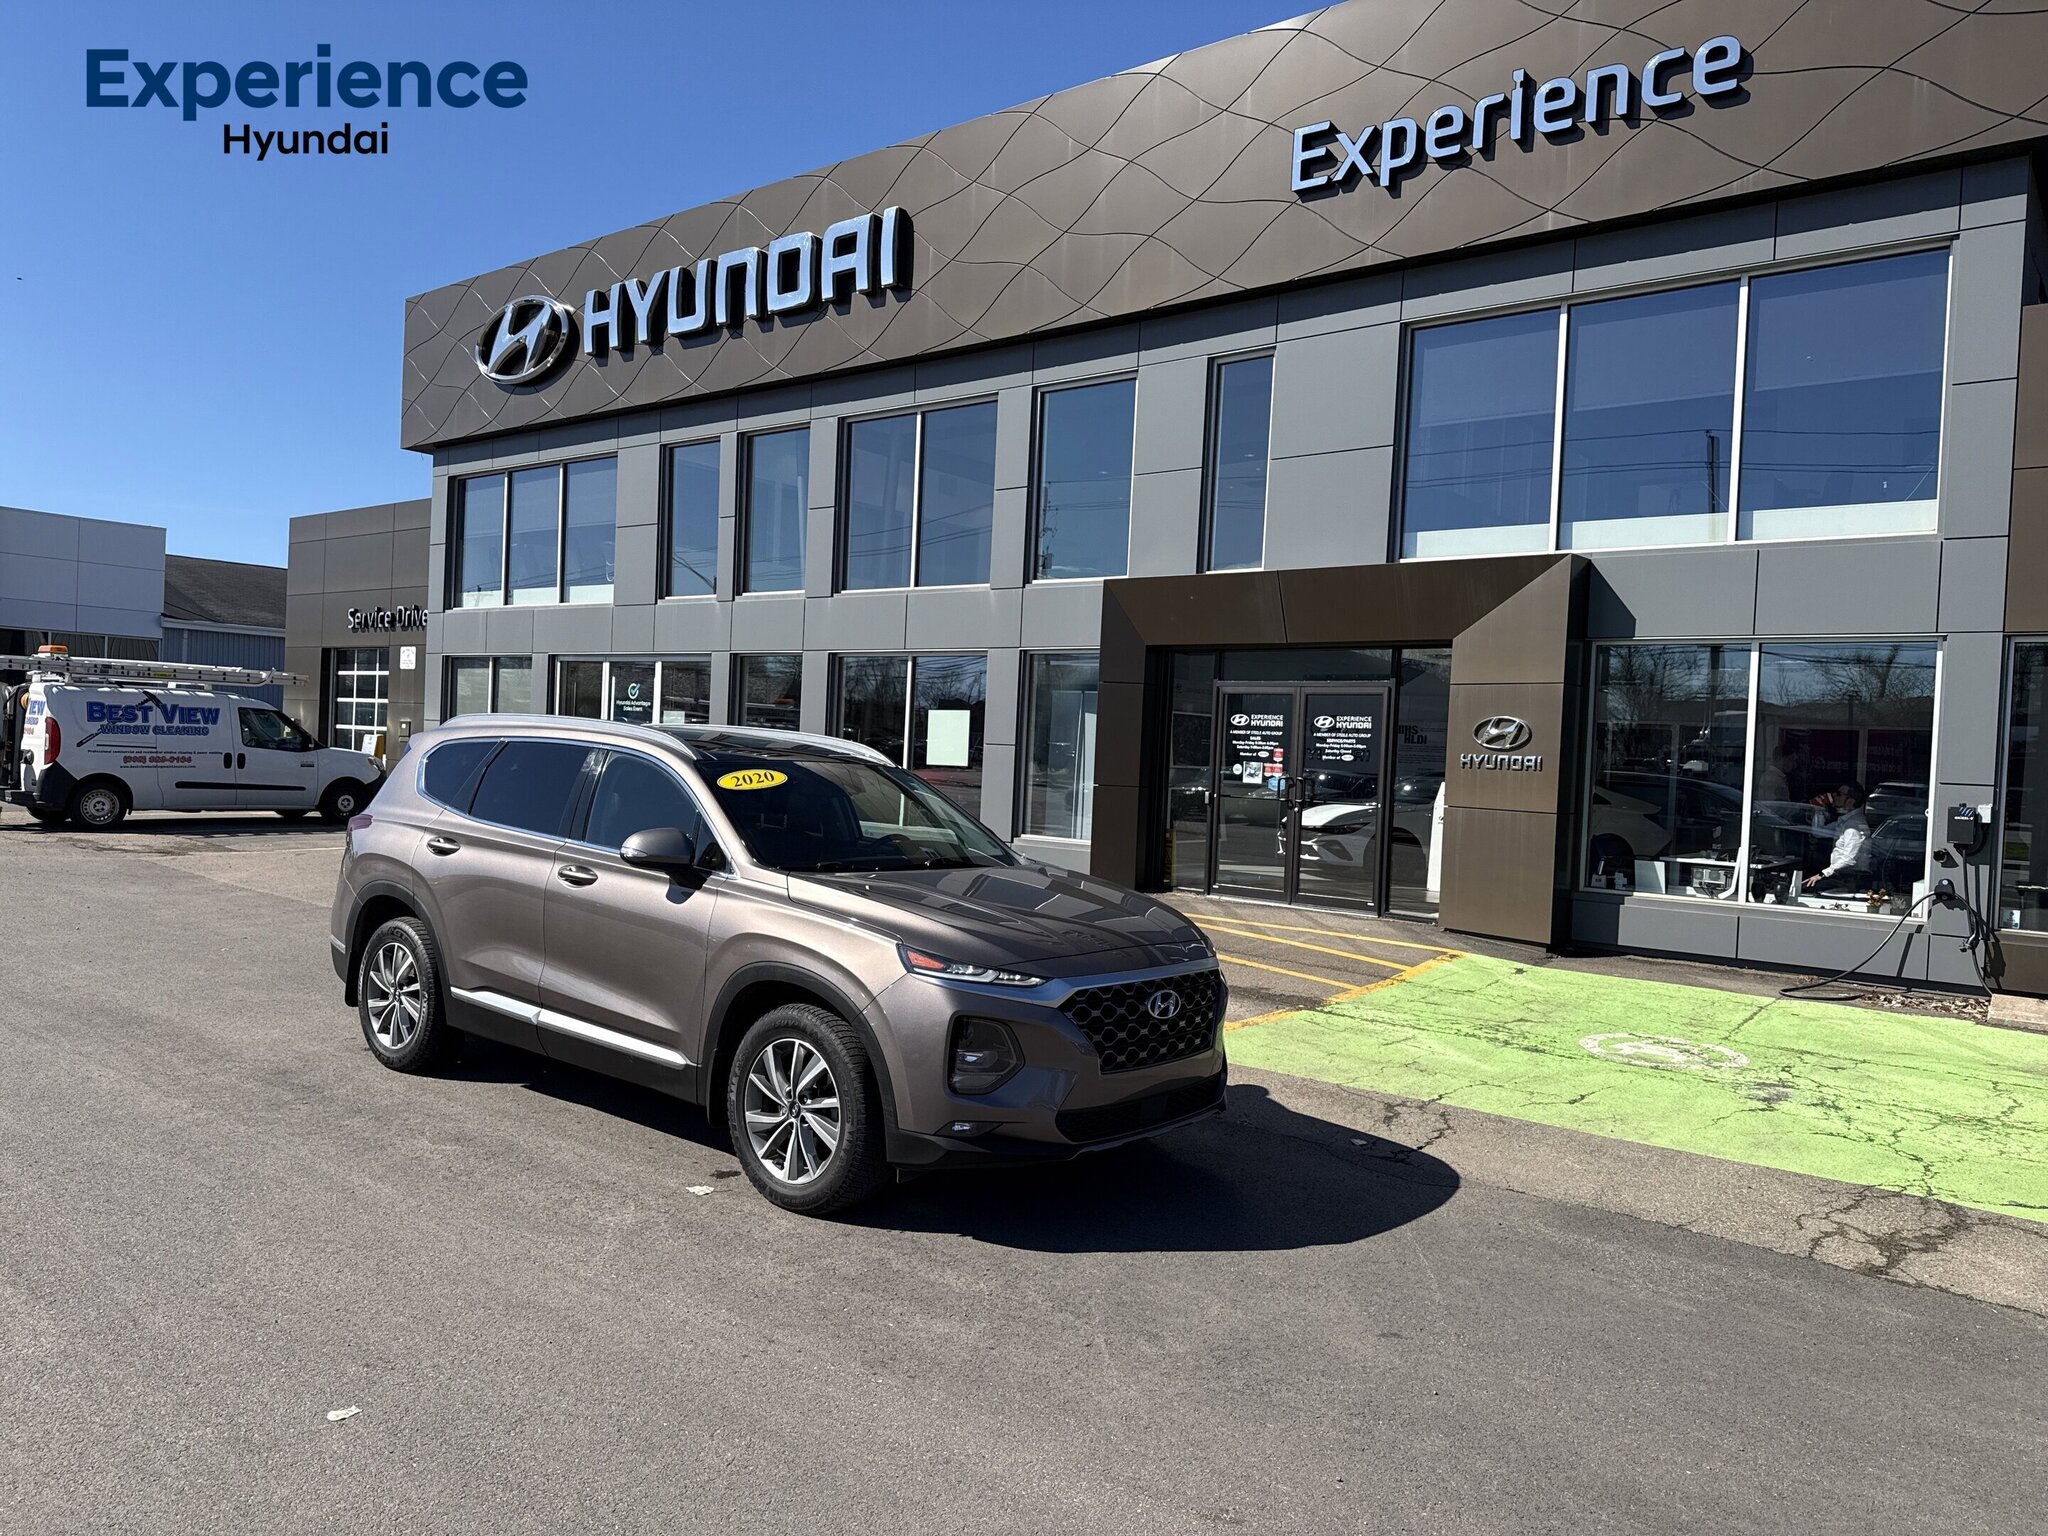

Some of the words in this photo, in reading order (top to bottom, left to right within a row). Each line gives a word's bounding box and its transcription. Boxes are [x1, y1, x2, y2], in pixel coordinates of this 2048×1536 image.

[1290, 34, 1748, 194] Experience
[583, 205, 912, 357] HYUNDAI
[347, 606, 392, 630] Service
[396, 604, 429, 628] Drive
[28, 699, 46, 716] IEW
[86, 701, 154, 724] BEST
[159, 703, 221, 725] VIEW
[100, 725, 150, 735] WINDOW
[152, 726, 210, 736] CLEANING
[1460, 753, 1543, 771] HYUNDAI
[730, 770, 775, 788] 2020
